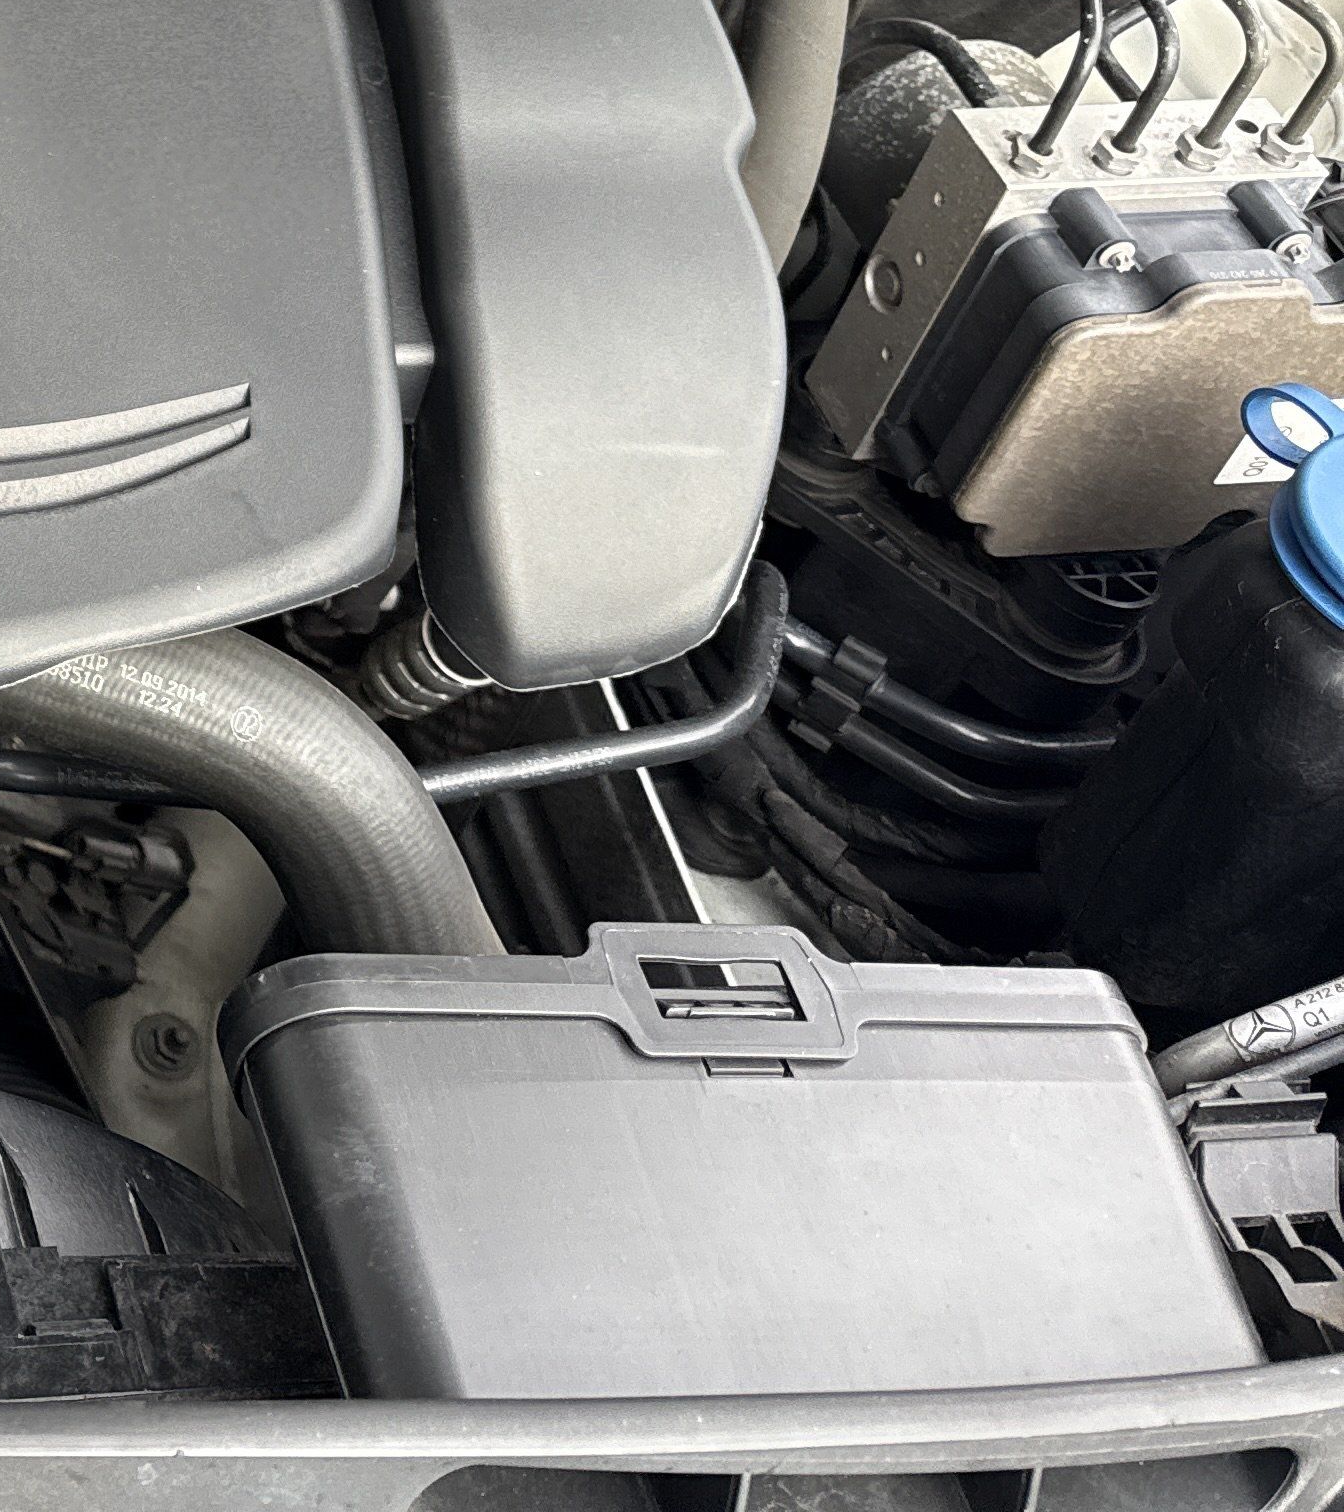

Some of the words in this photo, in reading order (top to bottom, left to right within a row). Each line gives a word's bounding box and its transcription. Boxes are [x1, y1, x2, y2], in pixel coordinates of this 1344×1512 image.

[1242, 455, 1269, 478] Q01
[1294, 998, 1306, 1008] A
[1306, 987, 1334, 1004] 212
[1303, 1007, 1330, 1027] Q1
